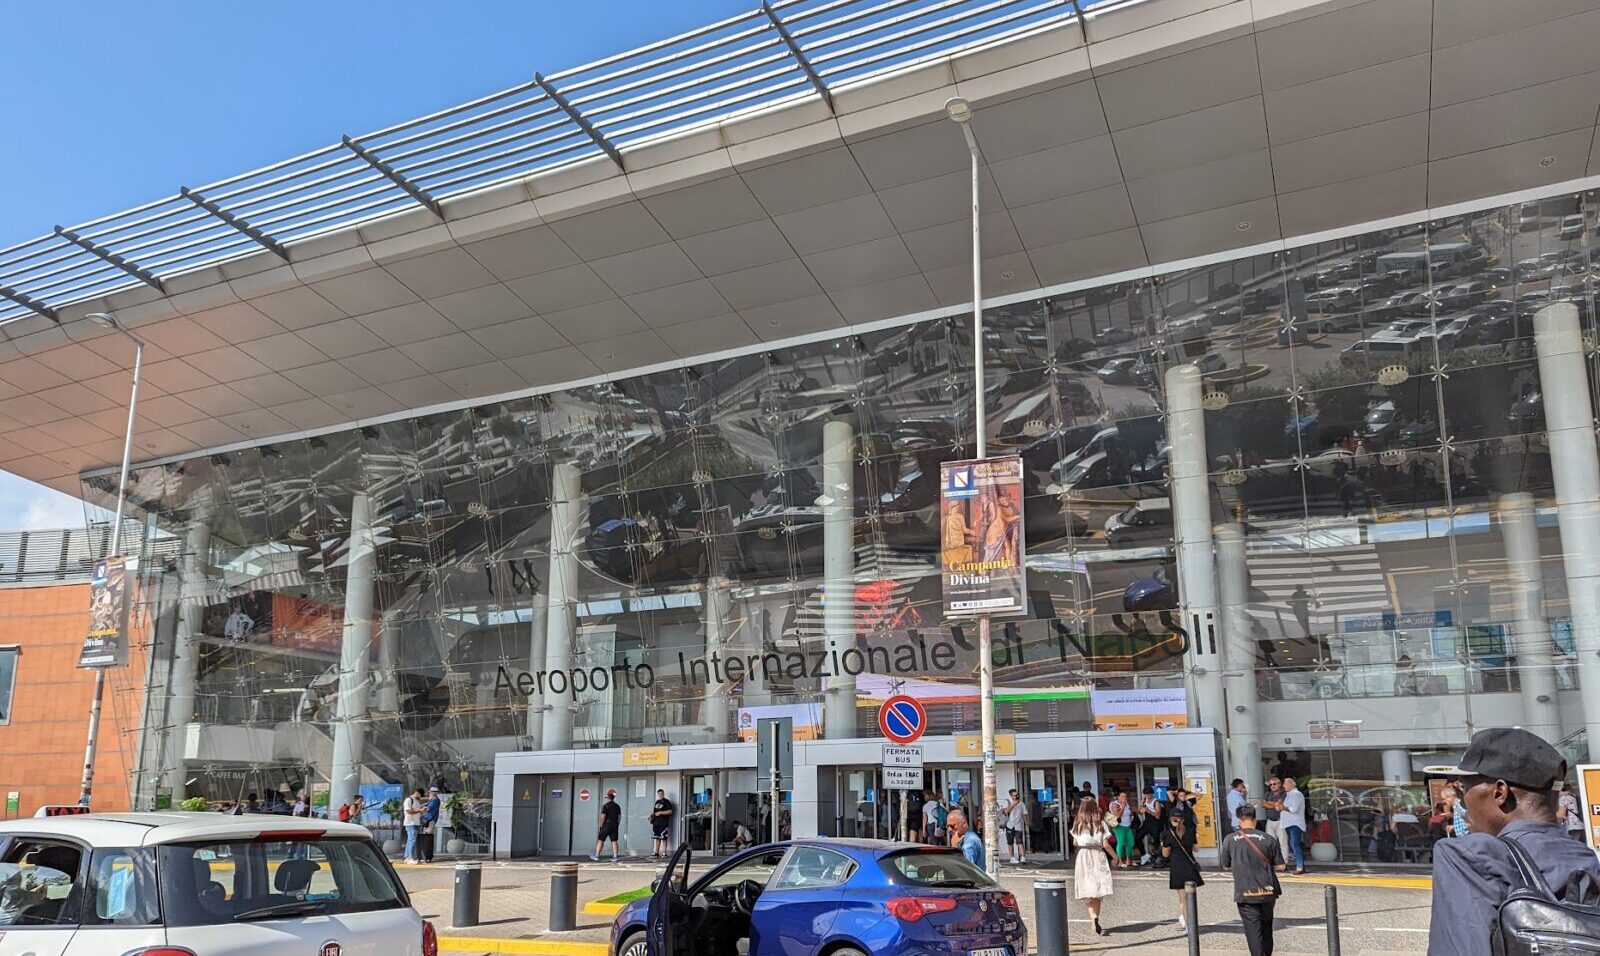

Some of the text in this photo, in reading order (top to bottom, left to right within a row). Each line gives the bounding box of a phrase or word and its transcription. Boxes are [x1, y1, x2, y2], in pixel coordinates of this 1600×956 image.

[950, 574, 990, 586] Divina
[493, 657, 655, 702] Aeroporto
[678, 633, 956, 685] Internazionale
[990, 622, 1024, 667] di
[47, 807, 88, 816] TAXI
